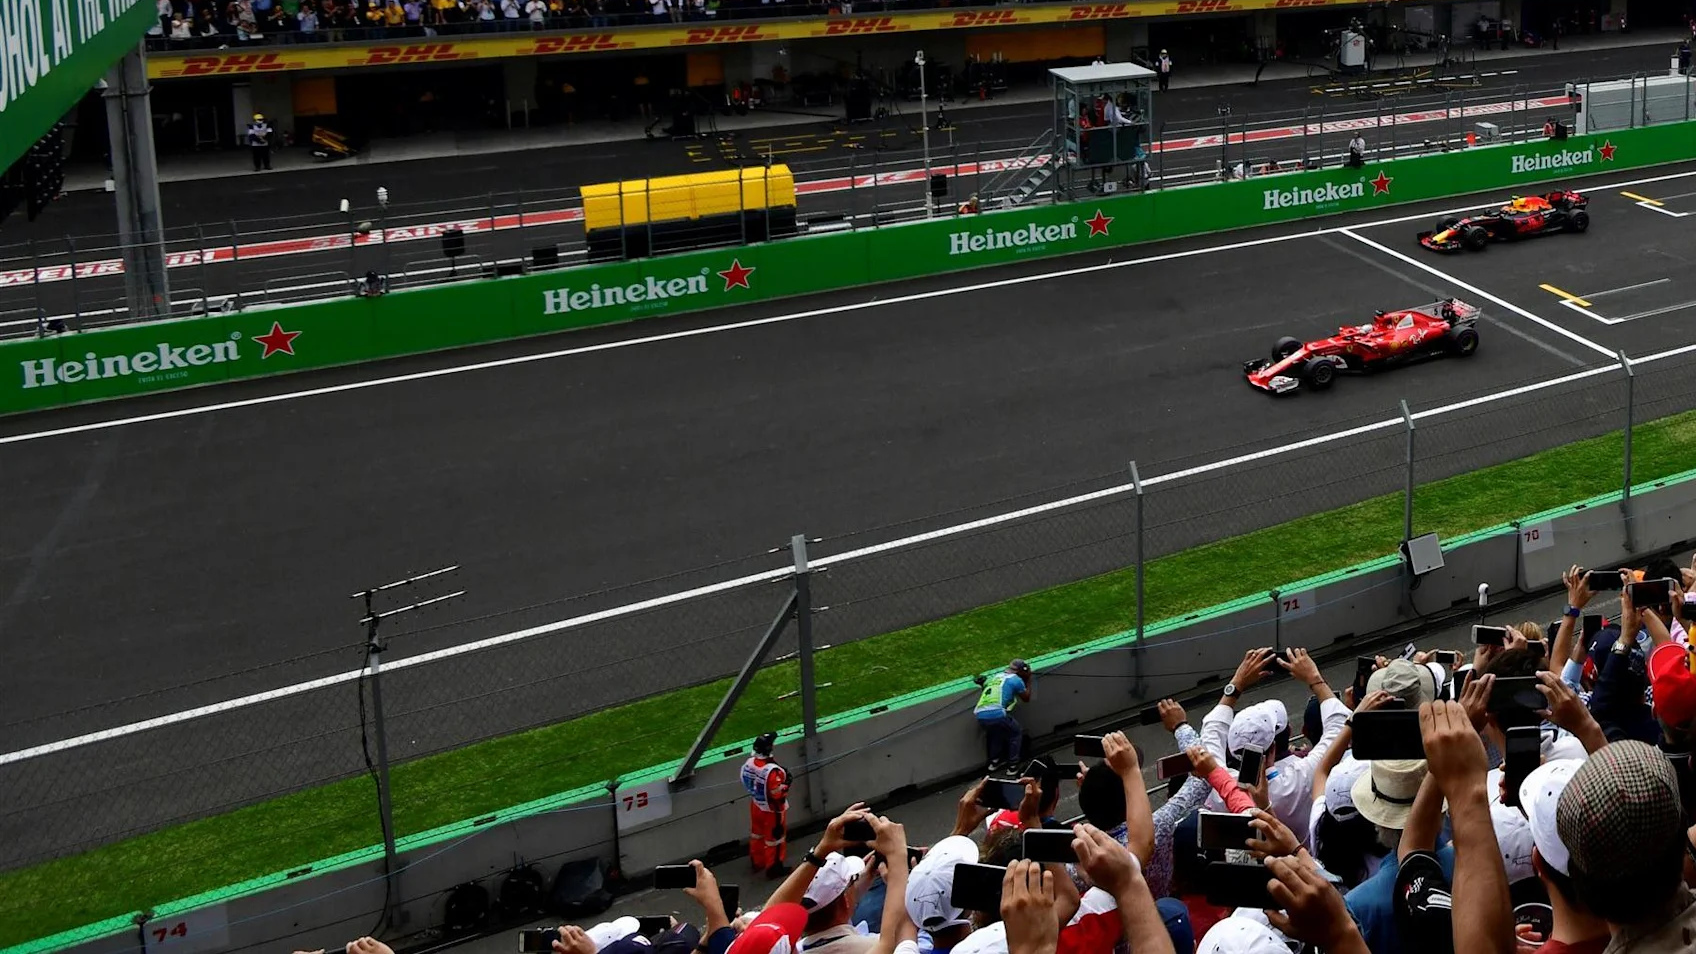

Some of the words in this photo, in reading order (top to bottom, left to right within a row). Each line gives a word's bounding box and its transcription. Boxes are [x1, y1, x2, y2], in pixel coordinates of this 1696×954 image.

[954, 10, 1015, 25] DHL
[1071, 4, 1128, 19] DHL
[687, 25, 760, 43] DHL
[827, 18, 894, 34] DHL
[367, 43, 457, 63] DHL
[535, 35, 616, 52] DHL
[182, 53, 286, 74] DHL
[1512, 150, 1593, 173] Heineken
[1263, 182, 1363, 209] Heineken
[950, 223, 1077, 254] Heineken
[543, 275, 709, 315] Heineken
[20, 339, 241, 389] Heineken
[1524, 529, 1539, 543] 70
[1283, 598, 1300, 612] 71
[623, 791, 649, 812] 73
[152, 922, 187, 943] 74
